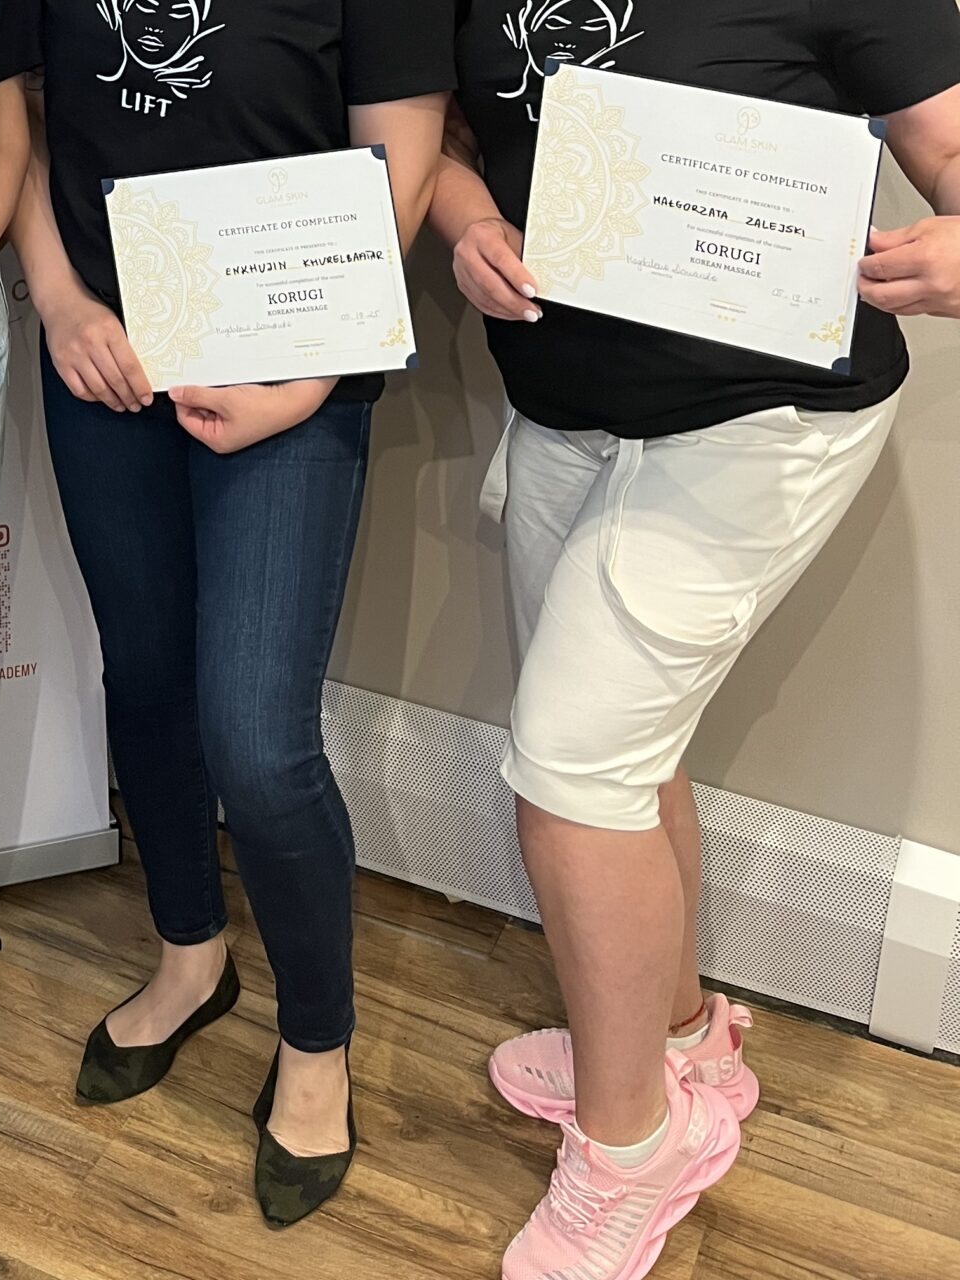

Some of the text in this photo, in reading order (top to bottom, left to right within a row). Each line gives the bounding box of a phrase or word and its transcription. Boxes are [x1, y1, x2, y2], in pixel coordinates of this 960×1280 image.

[121, 88, 173, 117] LIFT
[661, 153, 828, 195] CERTIFICATE OF COMPLETION
[218, 213, 357, 237] CERTIFICATE OF COMPLETION
[745, 216, 806, 237] ZALEJSKI
[695, 239, 761, 265] KORUGI
[225, 261, 287, 276] ENKHUJIN
[690, 257, 762, 278] KOREAN MASSAGE
[267, 288, 324, 305] KORUGI
[267, 304, 328, 316] KOREAN MASSAGE
